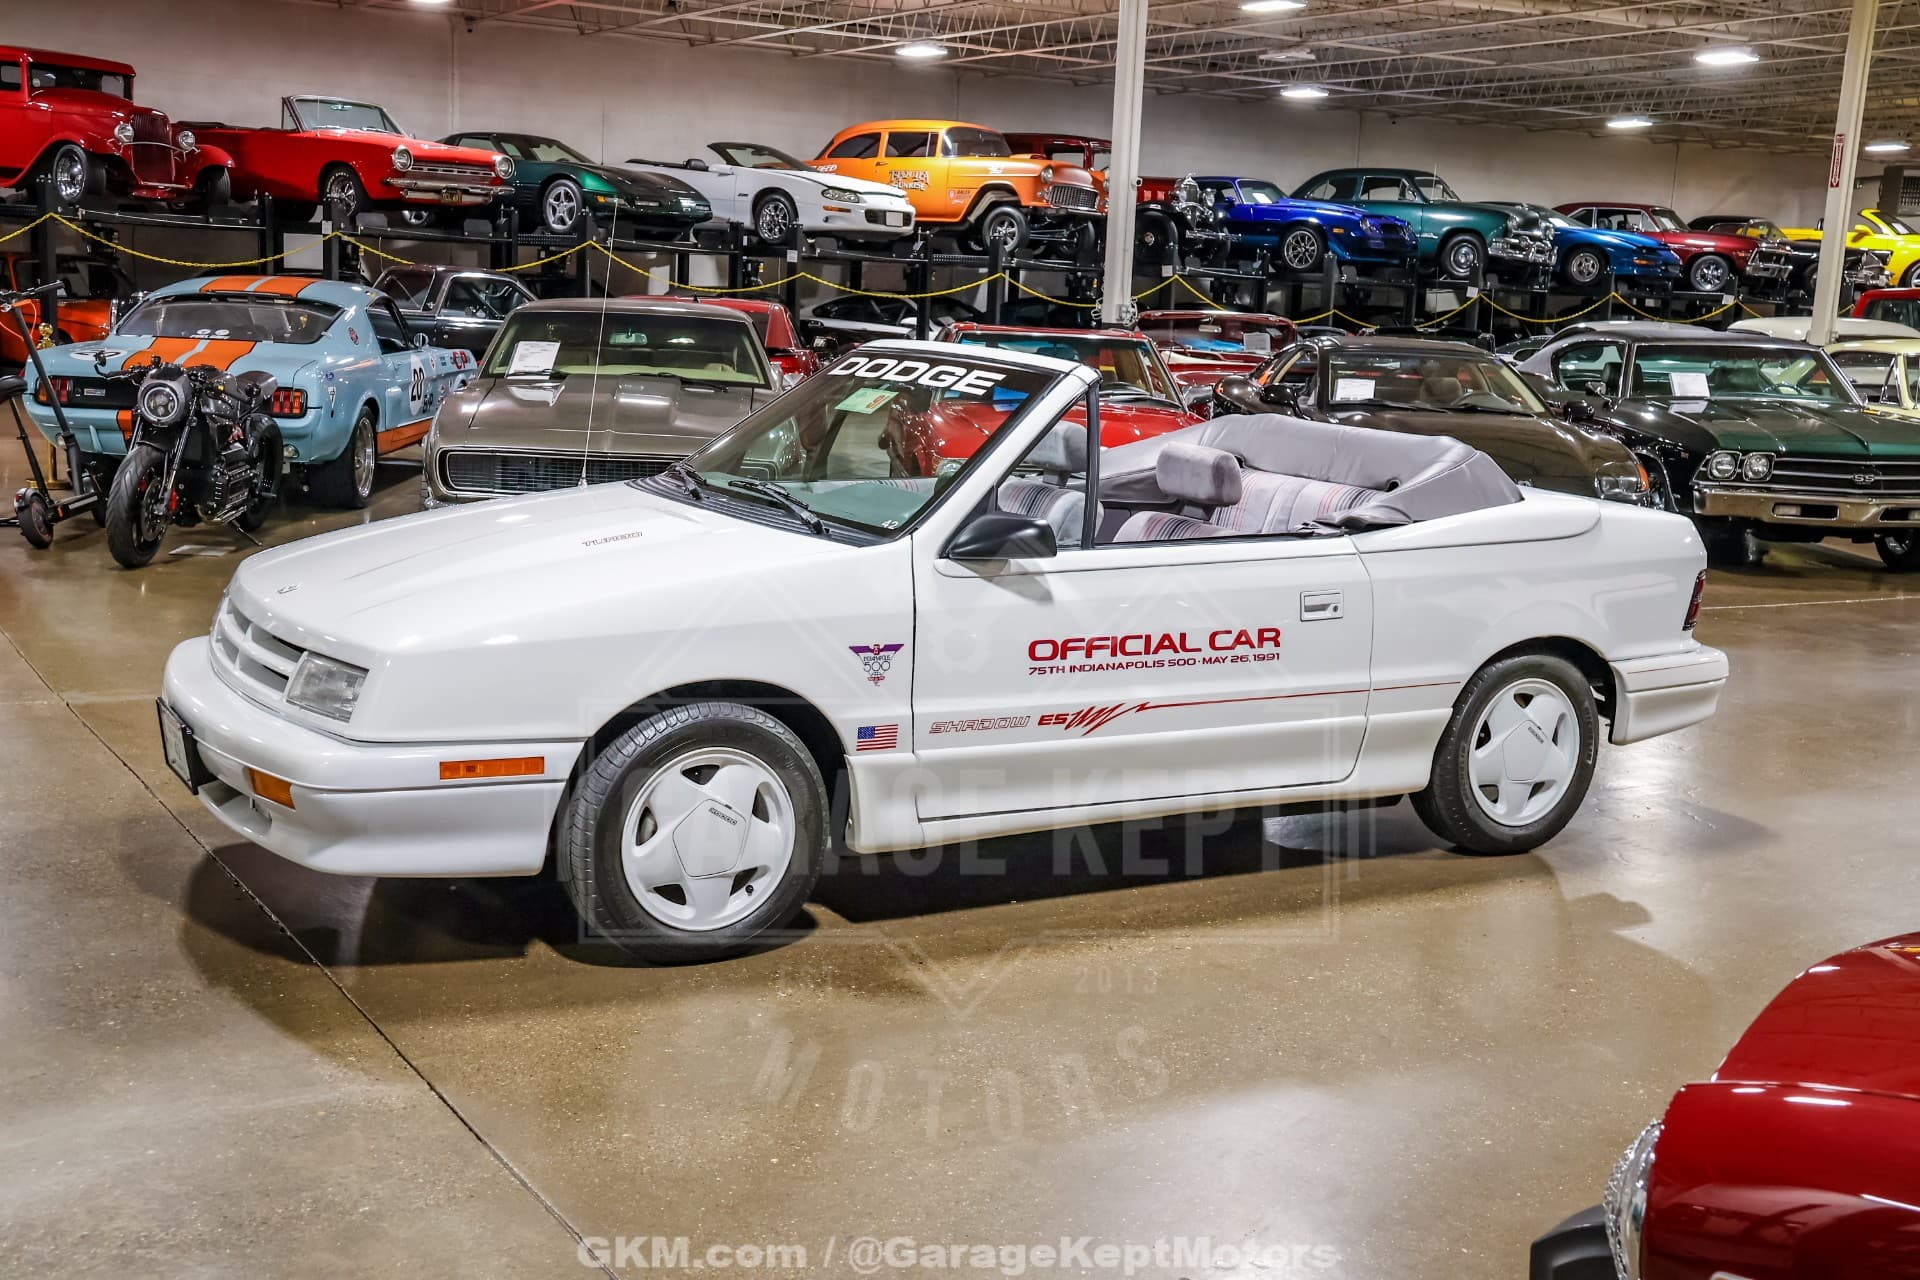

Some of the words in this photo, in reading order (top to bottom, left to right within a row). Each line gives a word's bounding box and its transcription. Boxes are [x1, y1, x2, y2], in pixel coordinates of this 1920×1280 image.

[410, 366, 425, 401] 20
[827, 357, 1007, 396] DODGE
[1854, 474, 1874, 482] SS
[881, 519, 899, 530] 42
[1028, 632, 1202, 662] OFFICIAL
[1208, 627, 1281, 651] CAR
[863, 661, 891, 672] 500
[1028, 665, 1066, 675] 75TH
[1069, 659, 1165, 673] INDIANAPOLIS
[929, 715, 1030, 734] SHADOW
[1037, 713, 1070, 726] ES
